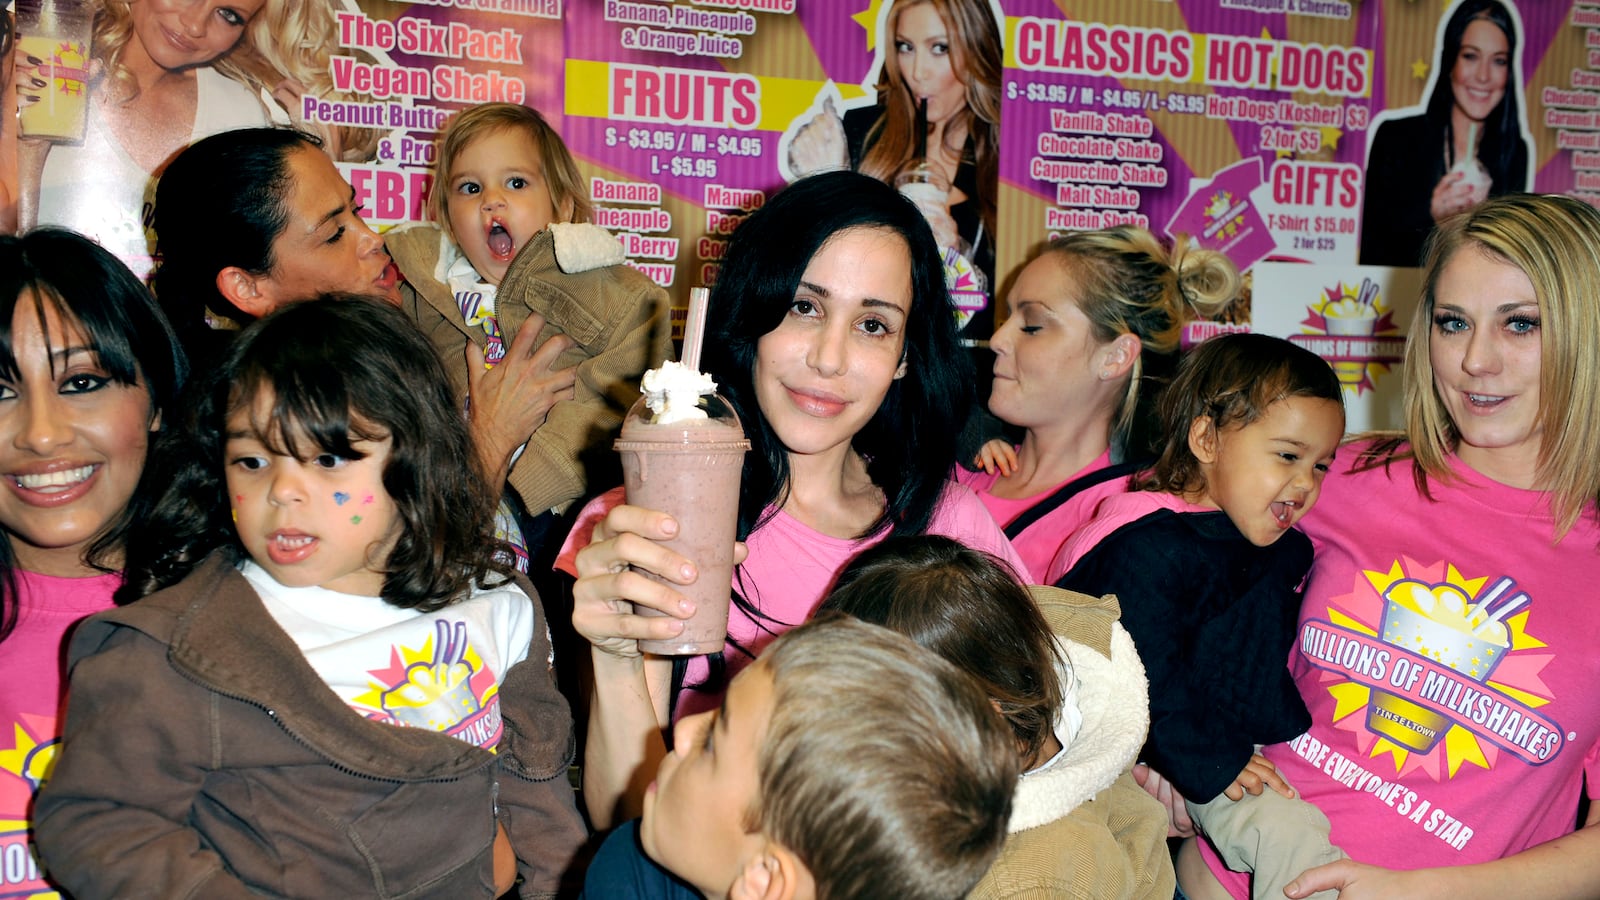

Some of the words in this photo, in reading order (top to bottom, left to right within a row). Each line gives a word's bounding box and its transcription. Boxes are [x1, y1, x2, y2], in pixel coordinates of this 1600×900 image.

[607, 2, 671, 25] Banana,
[675, 7, 754, 32] Pineapple
[337, 13, 394, 49] The
[400, 19, 448, 55] Six
[451, 26, 522, 62] Pack
[623, 30, 635, 45] &
[639, 29, 696, 52] Orange
[699, 34, 740, 55] Juice
[1018, 21, 1191, 79] CLASSICS
[1207, 38, 1275, 86] HOT
[1280, 45, 1366, 95] DOGS
[332, 58, 429, 99] Vegan
[434, 67, 524, 105] Shake
[612, 67, 758, 126] FRUITS
[1007, 82, 1018, 99] S
[1026, 82, 1067, 104] $3.95
[1080, 88, 1094, 105] M
[1102, 88, 1142, 109] $4.95
[1151, 93, 1159, 110] L
[1167, 93, 1205, 114] $5.95
[303, 96, 384, 126] Peanut
[389, 103, 456, 131] Butte
[1053, 111, 1103, 131] Vanilla
[1107, 113, 1150, 135] Shake
[1208, 99, 1236, 117] Hot
[1237, 100, 1276, 122] Dogs
[1347, 107, 1367, 128] $3
[379, 139, 396, 160] &
[400, 138, 437, 163] Pro
[605, 128, 617, 147] S
[628, 128, 675, 151] $3.95
[691, 133, 707, 153] M
[717, 135, 762, 157] $4.95
[1040, 135, 1114, 157] Chocolate
[1117, 140, 1160, 160] Shake
[1262, 129, 1272, 147] 2
[1275, 130, 1296, 149] for
[1299, 131, 1319, 151] $5
[651, 156, 661, 174] L
[671, 156, 717, 178] $5.95
[1032, 159, 1119, 182] Cappuccino
[1122, 164, 1165, 185] Shake
[592, 179, 659, 203] Banana
[707, 186, 763, 209] Mango
[1059, 186, 1090, 204] Malt
[1094, 187, 1138, 207] Shake
[1272, 162, 1358, 209] GIFTS
[591, 206, 669, 230] ineapple
[709, 213, 746, 232] Pea
[1047, 210, 1100, 228] Protein
[1267, 214, 1309, 231] T-Shirt
[1314, 216, 1355, 234] $15.00
[629, 235, 676, 258] Berry
[1302, 624, 1391, 681] MILLIONS
[1390, 657, 1424, 692] OF
[1418, 669, 1559, 761] MILKSHAKES
[1374, 706, 1438, 739] TINSELTOWN
[1286, 732, 1332, 769] HERE
[1322, 751, 1418, 816] EVERYONE'S
[1408, 799, 1432, 825] A
[1422, 808, 1474, 852] STAR
